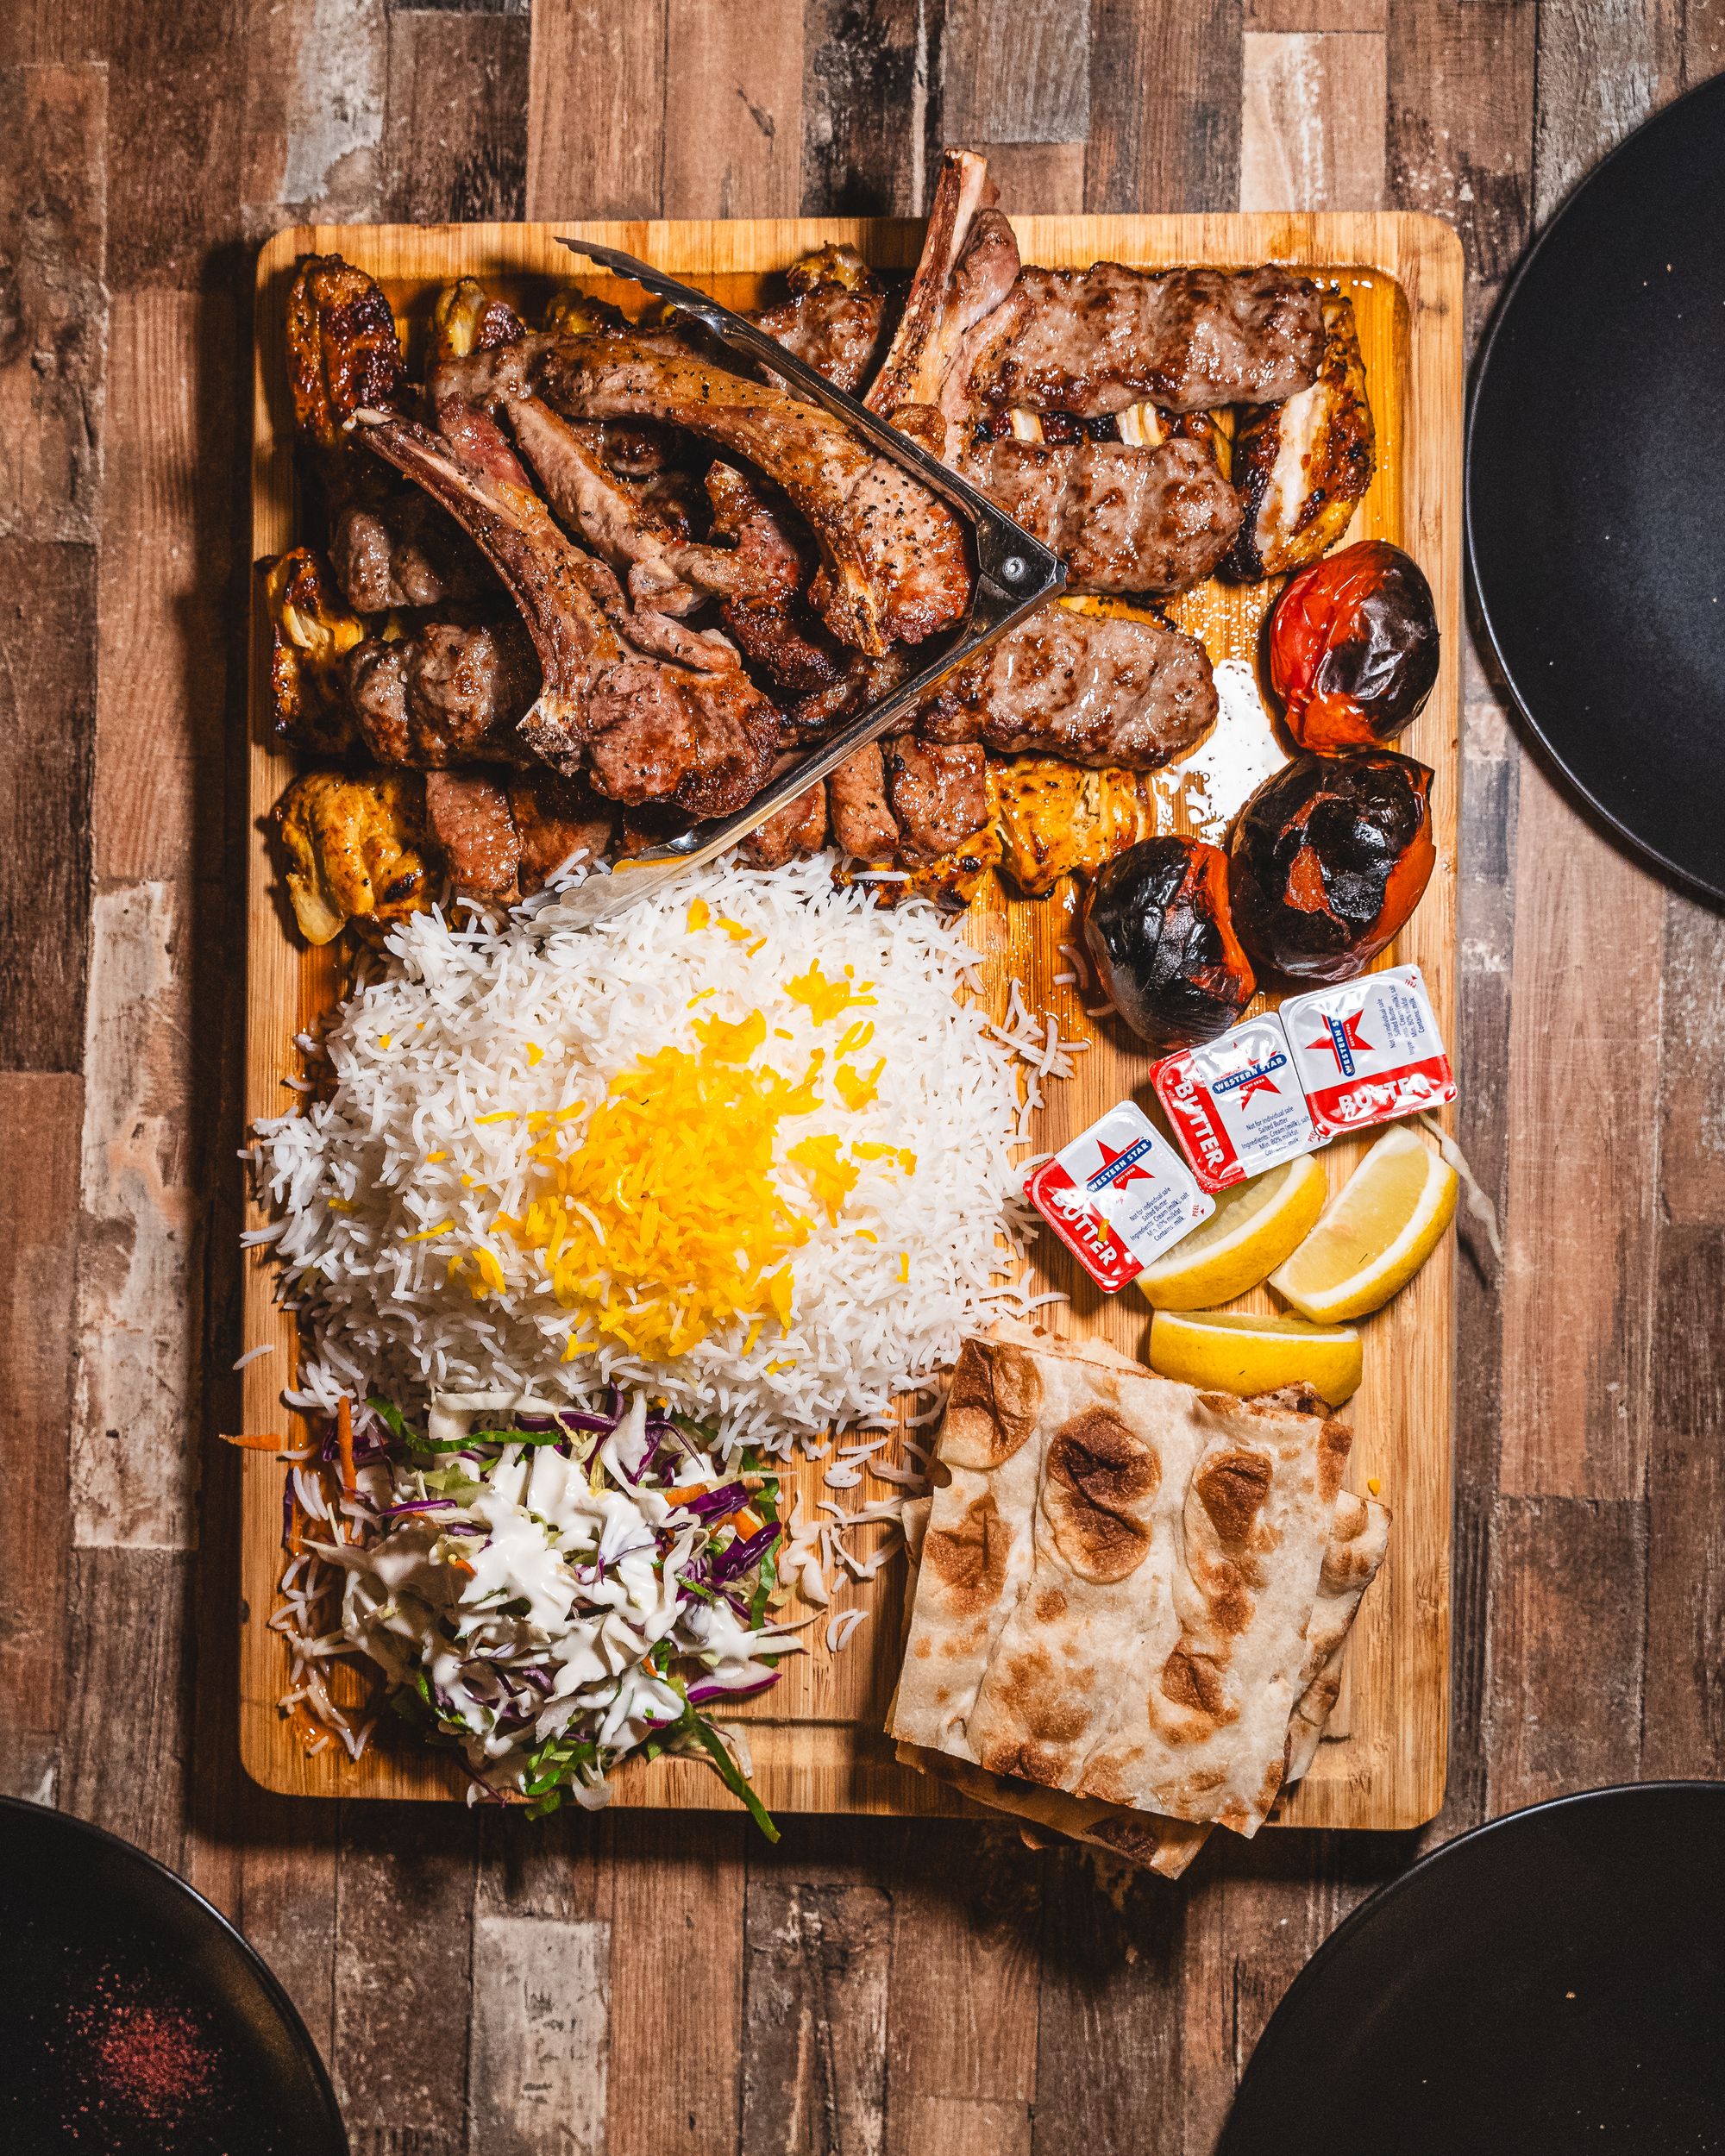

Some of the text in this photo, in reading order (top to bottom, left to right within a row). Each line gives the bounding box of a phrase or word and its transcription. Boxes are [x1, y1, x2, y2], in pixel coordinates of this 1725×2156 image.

[1379, 1008, 1390, 1031] individual
[1388, 1006, 1401, 1037] Salted Butter
[1333, 1028, 1353, 1074] WESTERN
[1402, 1026, 1414, 1055] Ingreents:
[1214, 1056, 1283, 1092] WESTERN STAR
[1337, 1071, 1428, 1114] BUTE
[1173, 1080, 1226, 1168] BUTTER
[1258, 1118, 1288, 1134] Salted Butter
[1261, 1109, 1284, 1124] individual
[1284, 1106, 1294, 1114] sale
[1269, 1127, 1285, 1137] Cream
[1088, 1142, 1149, 1192] WESTERN STAR
[1129, 1213, 1138, 1221] Not
[1143, 1192, 1163, 1211] individual
[1162, 1187, 1171, 1196] sale
[1141, 1199, 1167, 1221] Salted Butter
[1152, 1209, 1168, 1221] Cream
[1191, 1203, 1200, 1217] PEEL
